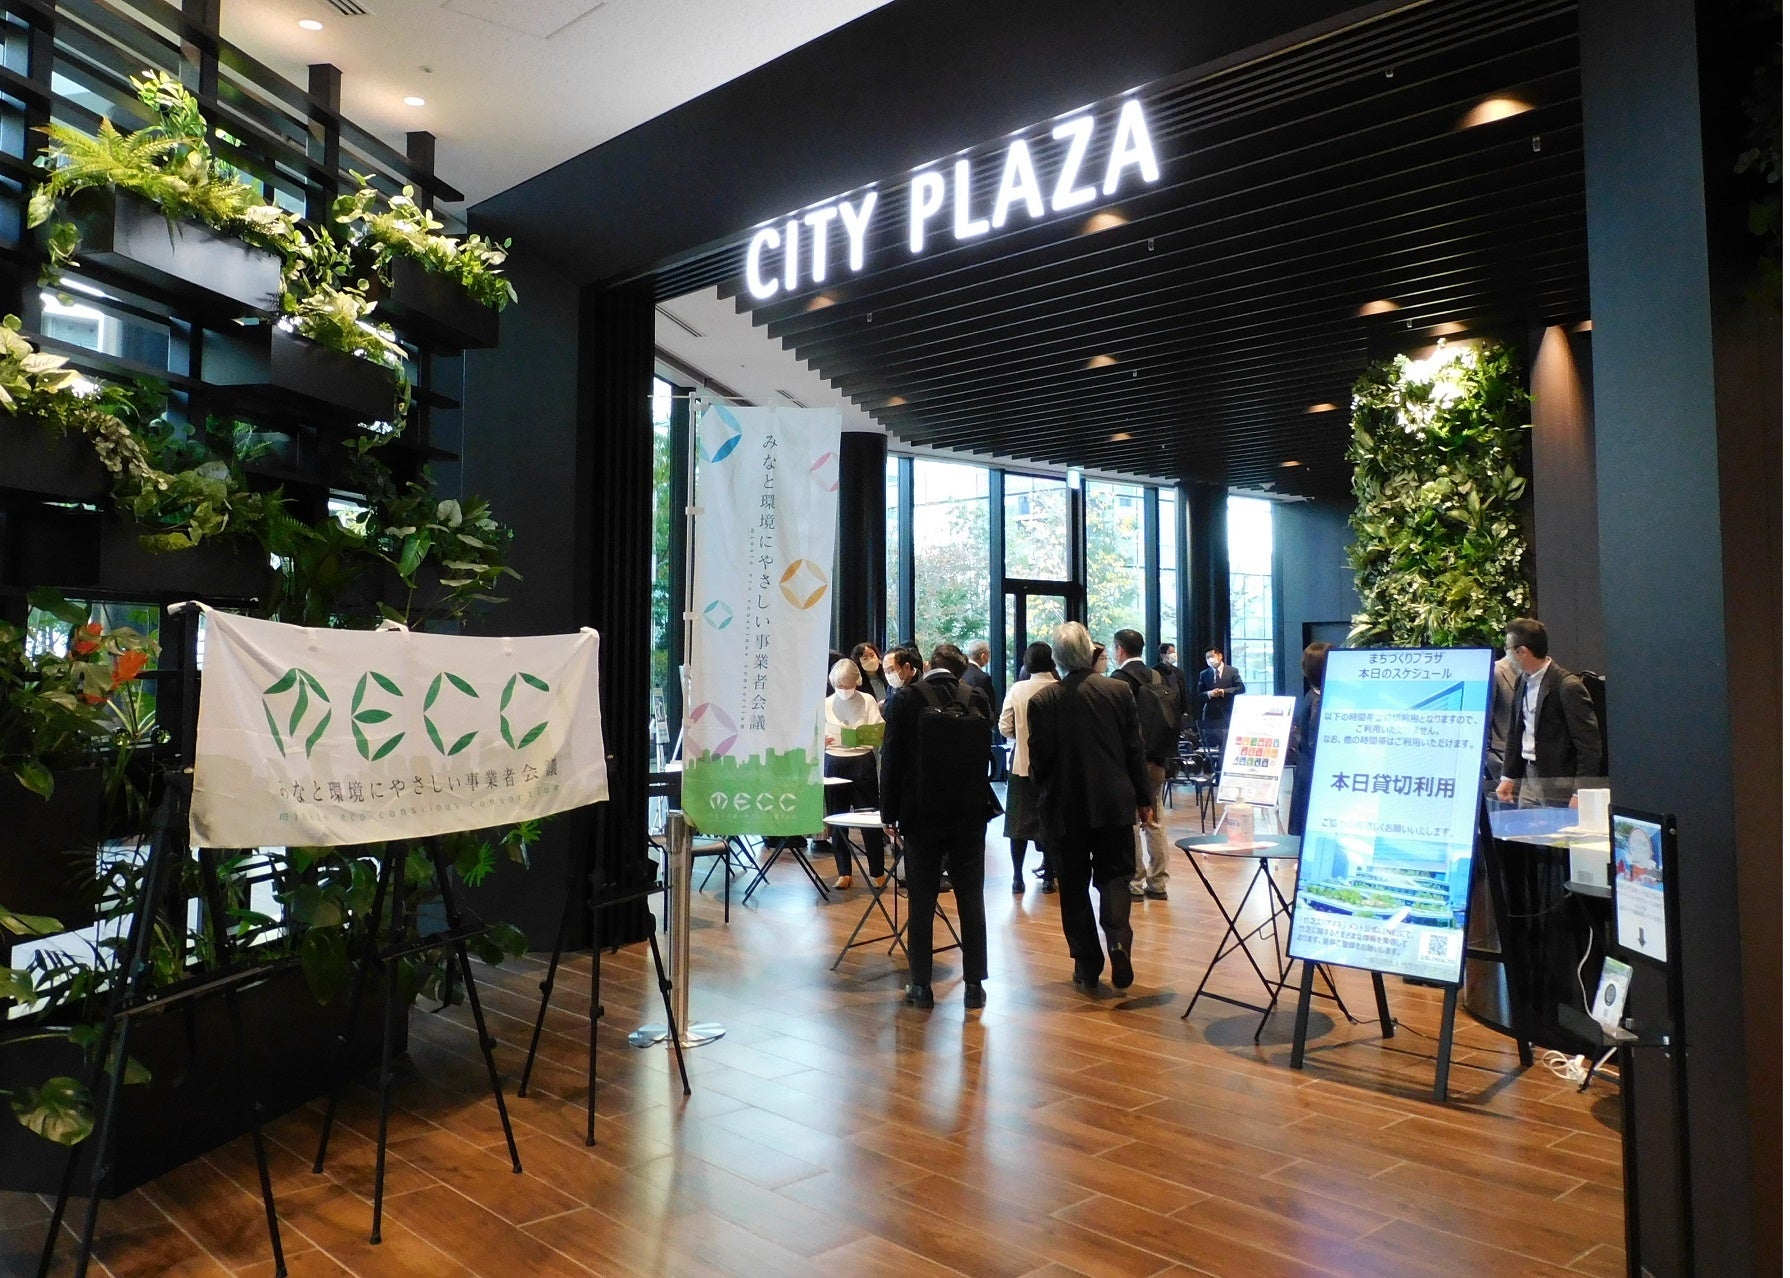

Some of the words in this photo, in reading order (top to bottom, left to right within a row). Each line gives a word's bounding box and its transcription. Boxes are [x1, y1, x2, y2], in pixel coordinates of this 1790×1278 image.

[745, 190, 879, 300] CITY
[909, 99, 1160, 254] PLAZA
[750, 434, 778, 732] みなと環境にやさしい事業者会議
[262, 668, 550, 762] MECC
[1357, 667, 1453, 680] 本日のスケジュール
[1329, 771, 1457, 799] 本日貸切利用
